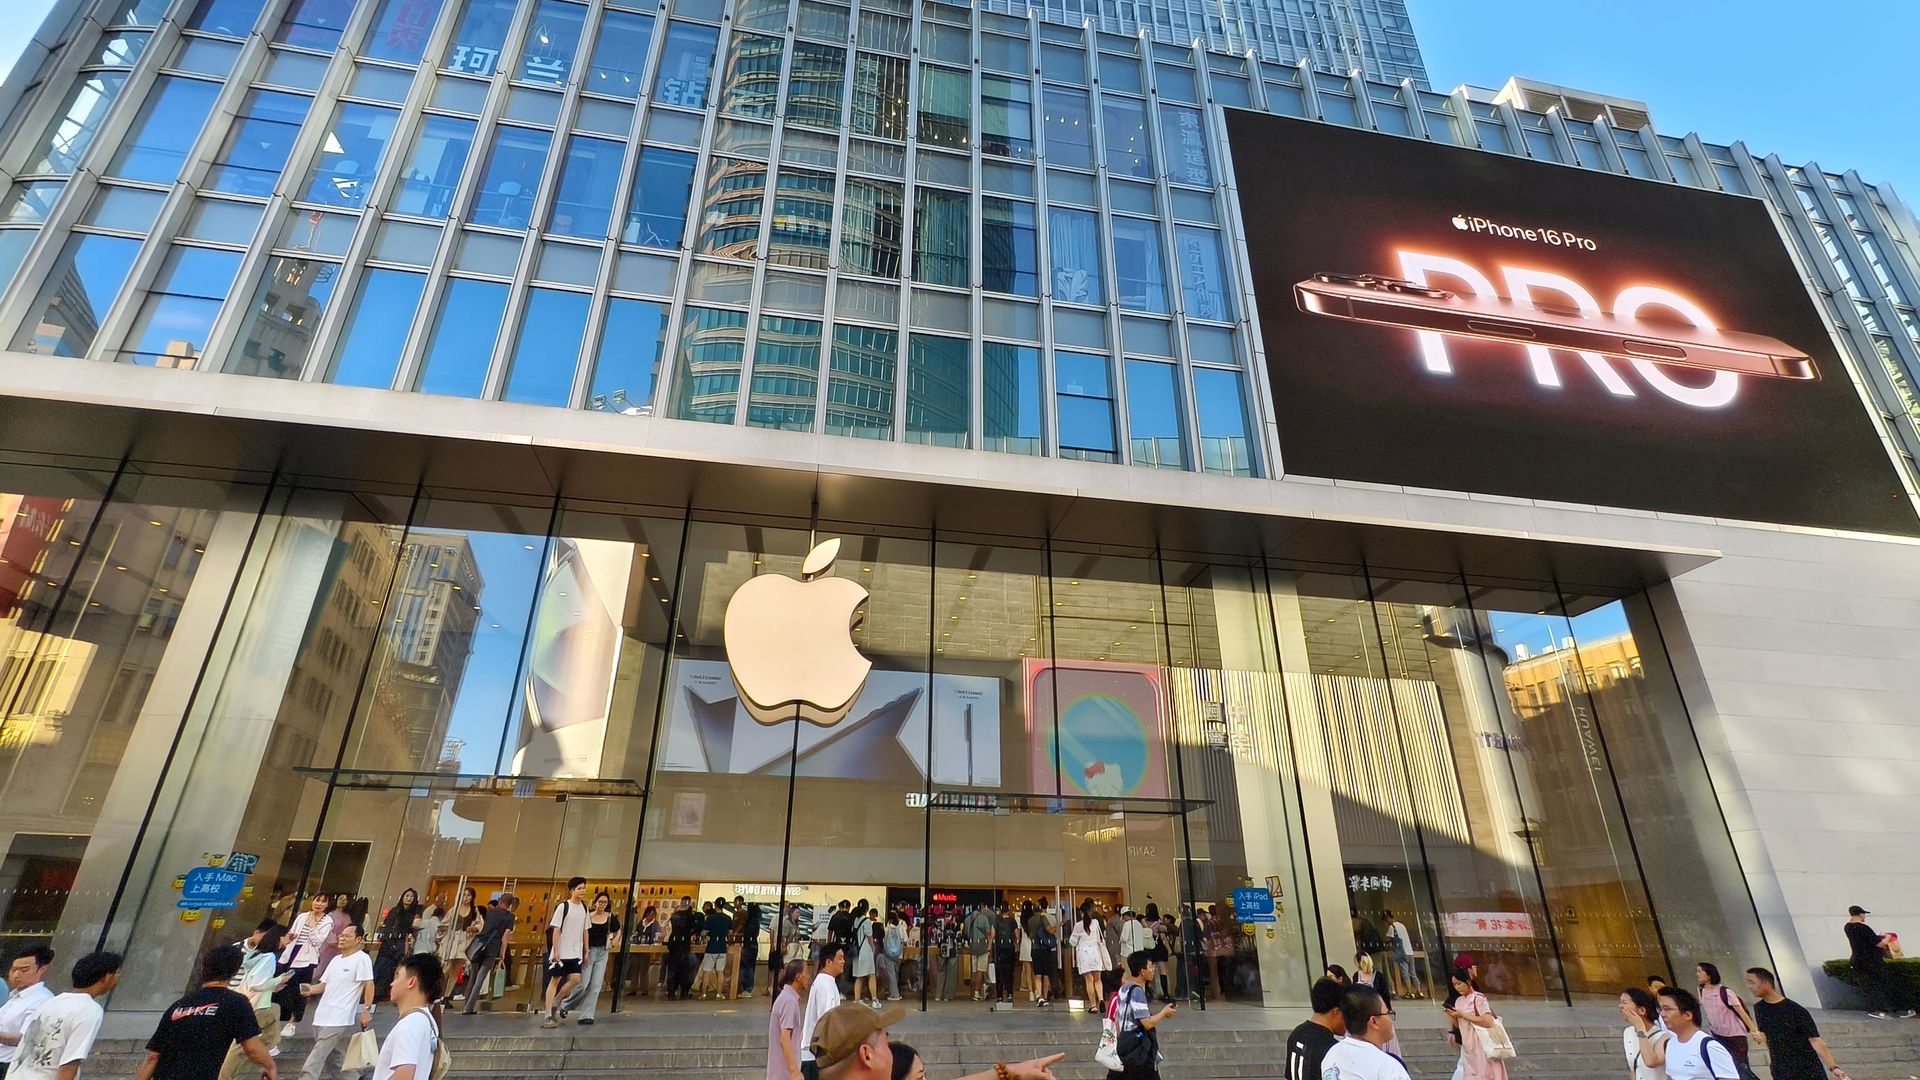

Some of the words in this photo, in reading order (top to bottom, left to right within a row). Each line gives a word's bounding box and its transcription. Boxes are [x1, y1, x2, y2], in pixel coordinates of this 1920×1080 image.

[1468, 216, 1537, 242] iPhone
[1538, 228, 1561, 246] 16
[1562, 232, 1597, 251] Pro
[1398, 250, 1739, 408] PRO
[194, 872, 215, 883] 入手
[215, 872, 238, 883] Mac
[939, 893, 957, 901] Music
[1253, 892, 1268, 900] iPad
